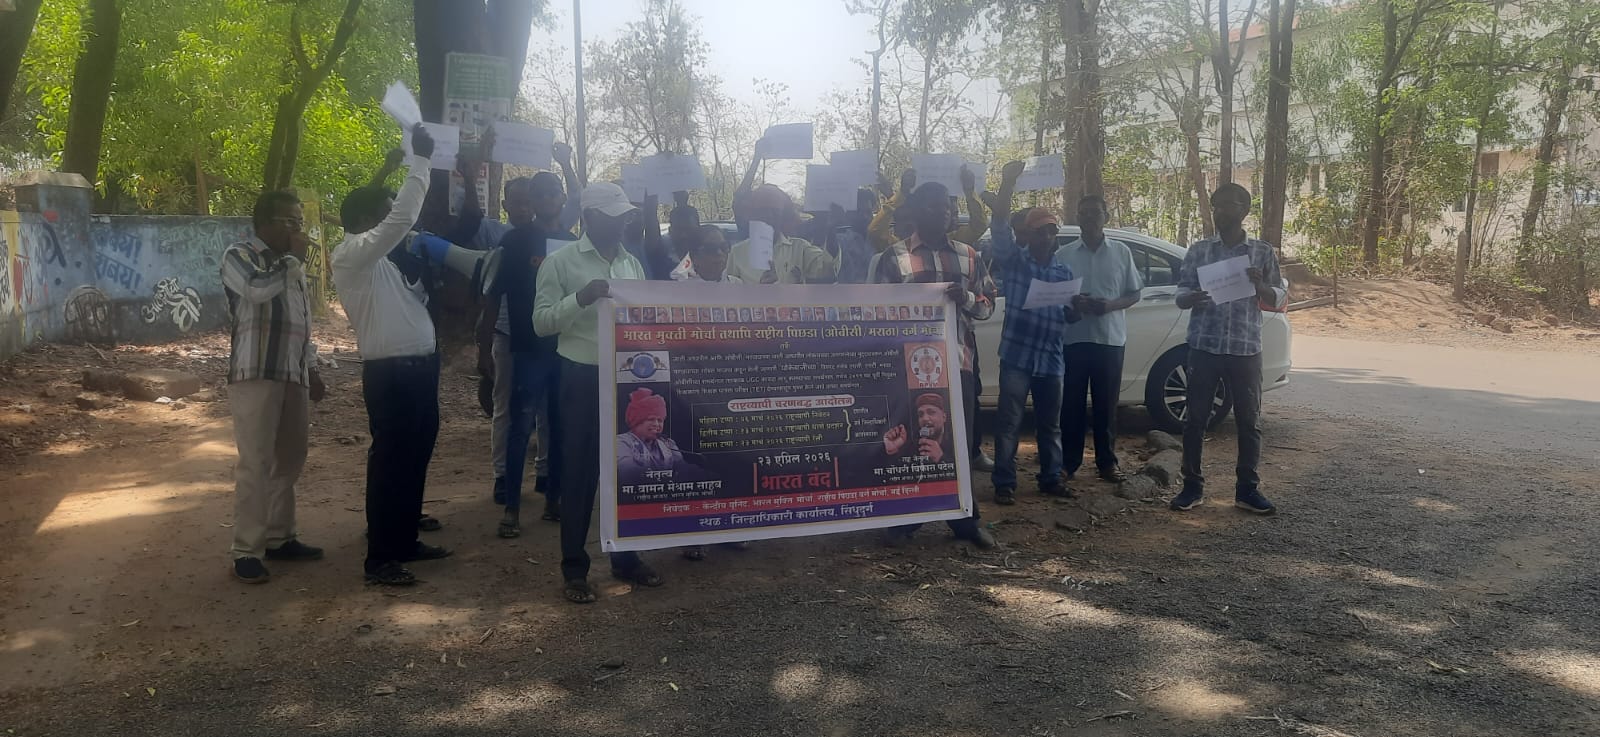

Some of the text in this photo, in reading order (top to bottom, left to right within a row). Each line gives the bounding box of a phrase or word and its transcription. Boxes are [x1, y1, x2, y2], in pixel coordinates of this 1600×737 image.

[624, 330, 651, 341] भारत
[656, 326, 686, 344] मुक्ती
[690, 326, 715, 340] मोर्चा
[720, 325, 751, 340] तथापि
[755, 326, 783, 340] राष्ट्रीय
[787, 325, 817, 338] पिछडा
[902, 324, 917, 336] वर्ग
[729, 399, 771, 410] राष्ट्रव्यापी
[775, 399, 812, 409] चरणबद्ध
[757, 451, 831, 467] २३ एप्रिल २०२६
[646, 468, 673, 481] नेतृत्व
[761, 466, 831, 490] भारत बंद
[668, 480, 694, 492] मेश्राम
[663, 503, 690, 513] निवेदक
[752, 498, 772, 507] भारत
[698, 516, 721, 527] स्थळ
[731, 509, 793, 525] जिल्हाधिकारी
[841, 502, 874, 517] सिंधुदुर्ग
